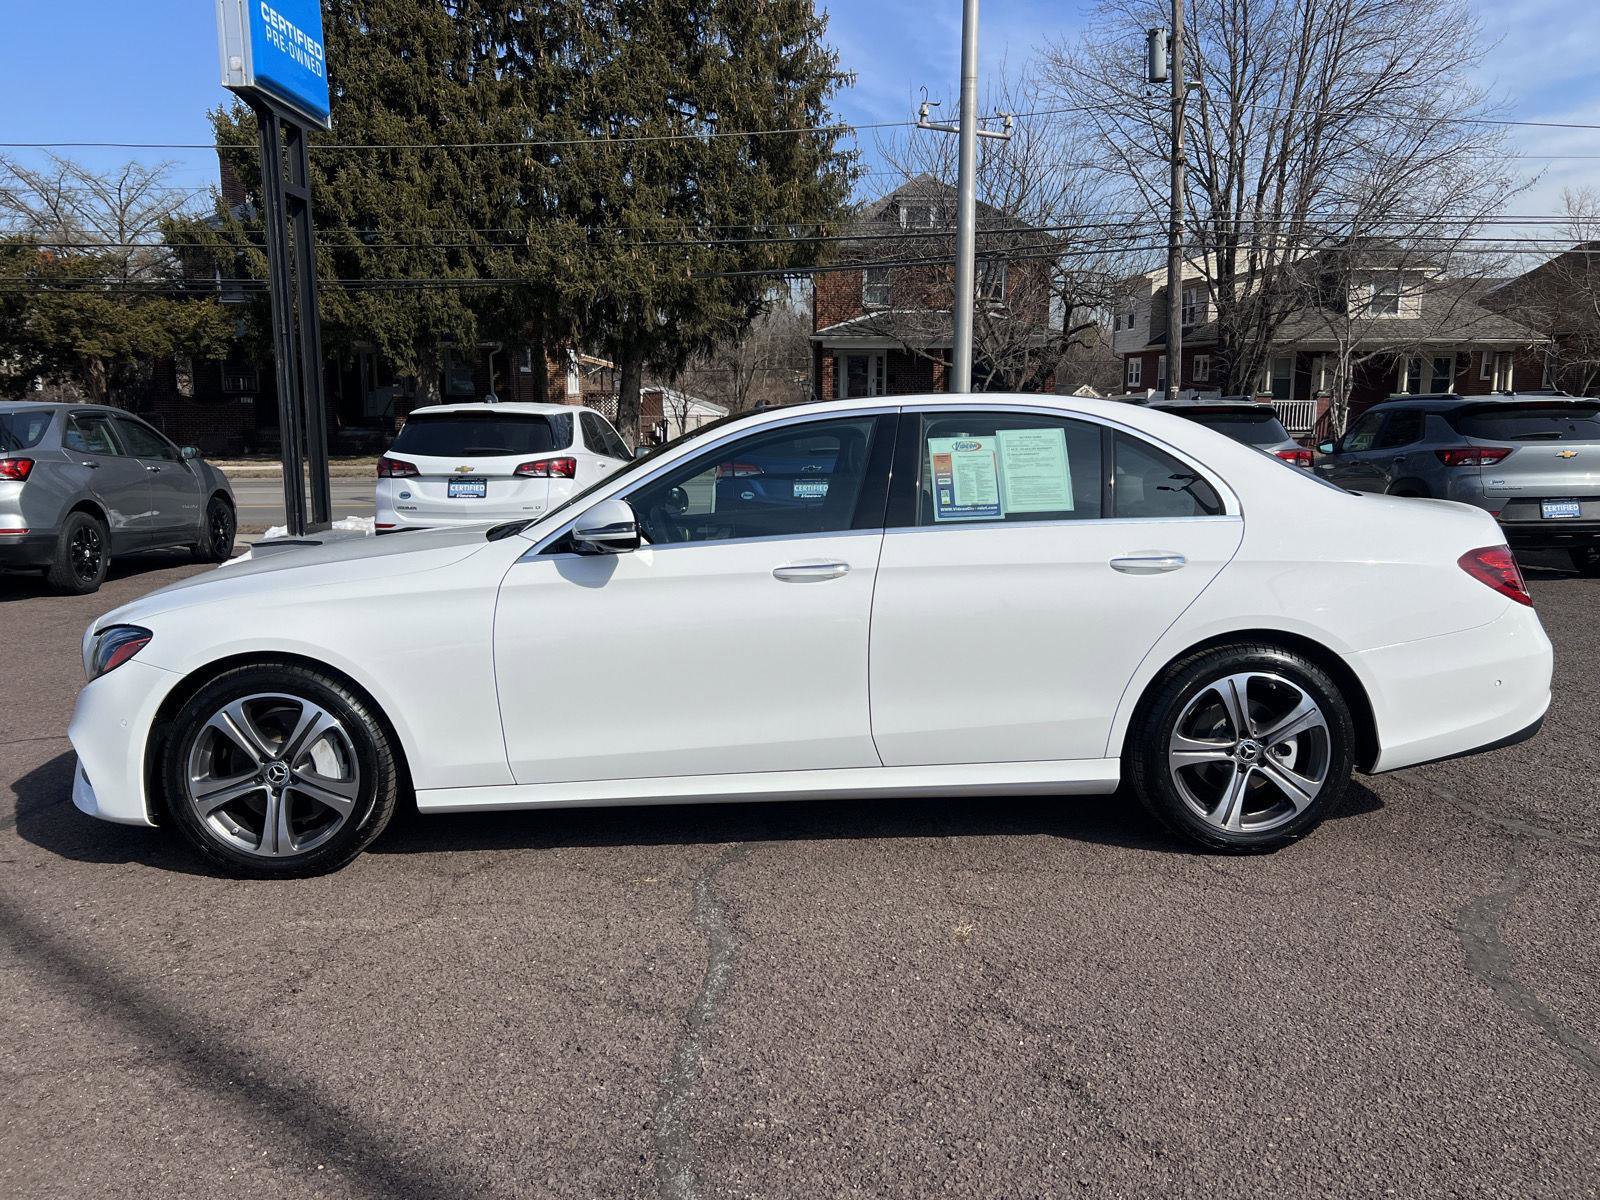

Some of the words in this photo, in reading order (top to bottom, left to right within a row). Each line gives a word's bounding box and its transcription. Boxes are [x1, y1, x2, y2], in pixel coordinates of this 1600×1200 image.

[260, 1, 323, 61] CERTIFIED
[265, 25, 322, 78] PRE-OWNED
[450, 484, 486, 492] CERTIFIED
[793, 484, 829, 492] CERTIFIED
[1543, 504, 1579, 512] CERTIFIED
